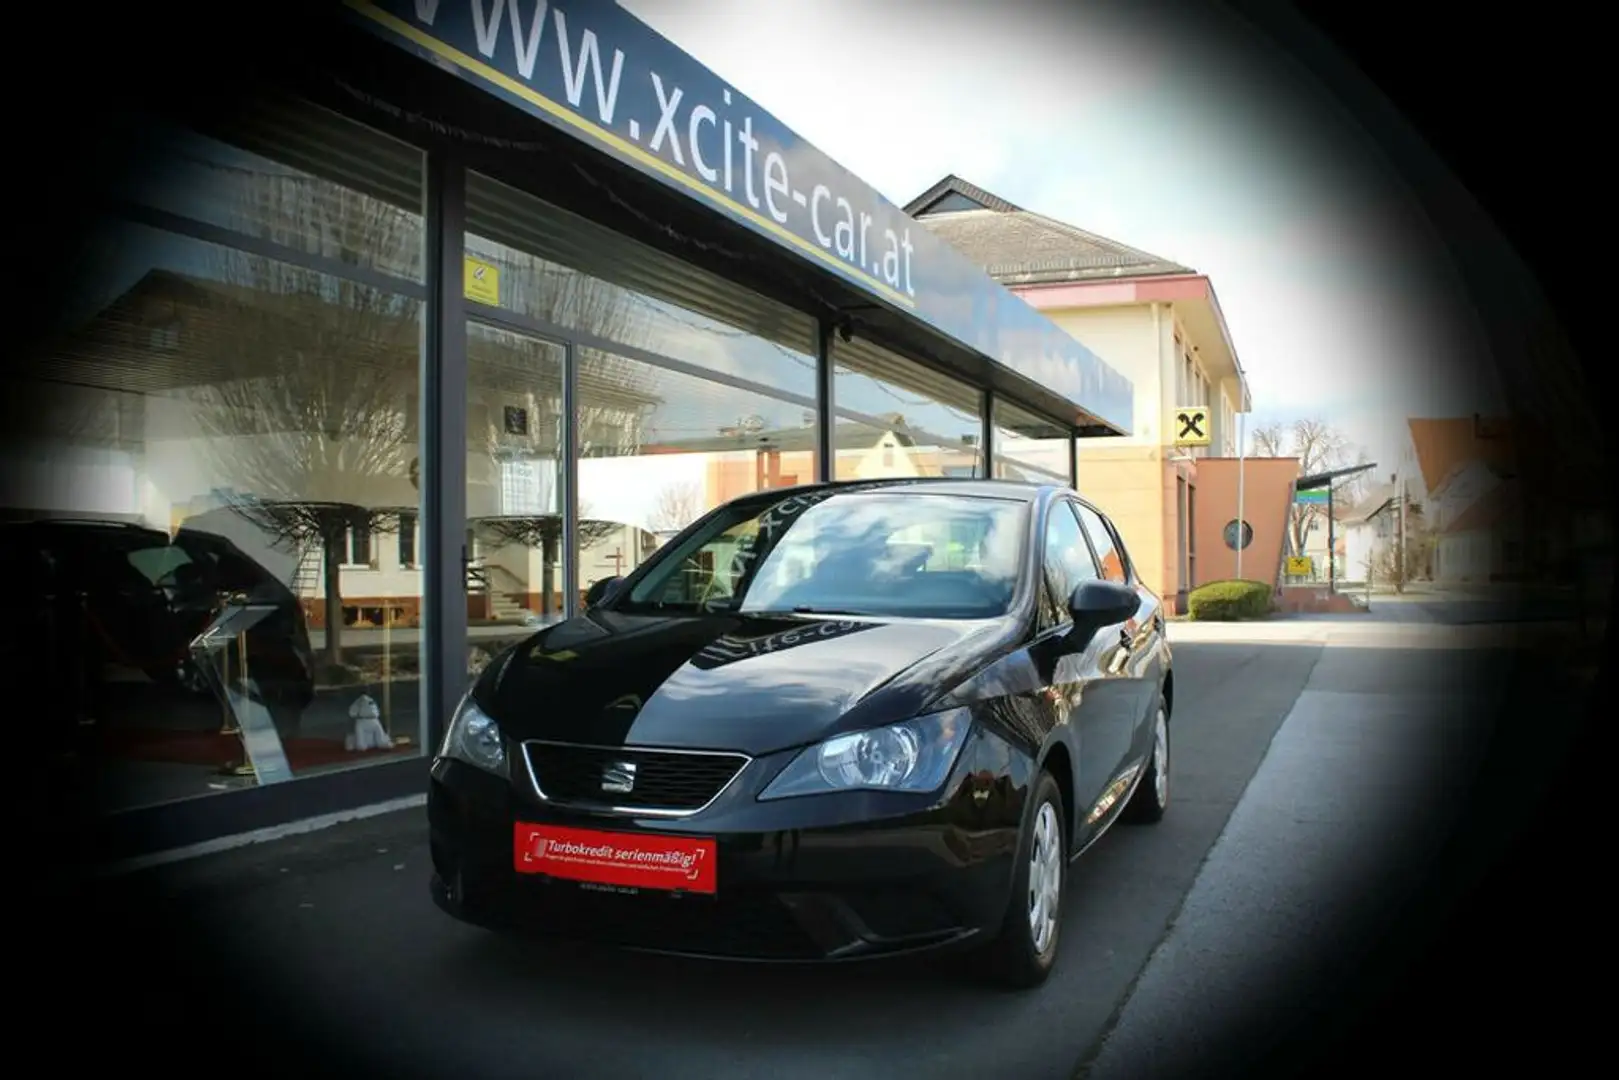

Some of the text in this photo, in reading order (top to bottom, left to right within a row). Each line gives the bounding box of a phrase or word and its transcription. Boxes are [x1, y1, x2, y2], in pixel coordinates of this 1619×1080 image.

[413, 0, 915, 298] ww.xcite-car.at
[548, 839, 613, 858] Turbokredit
[614, 847, 697, 868] serienmäßig!
